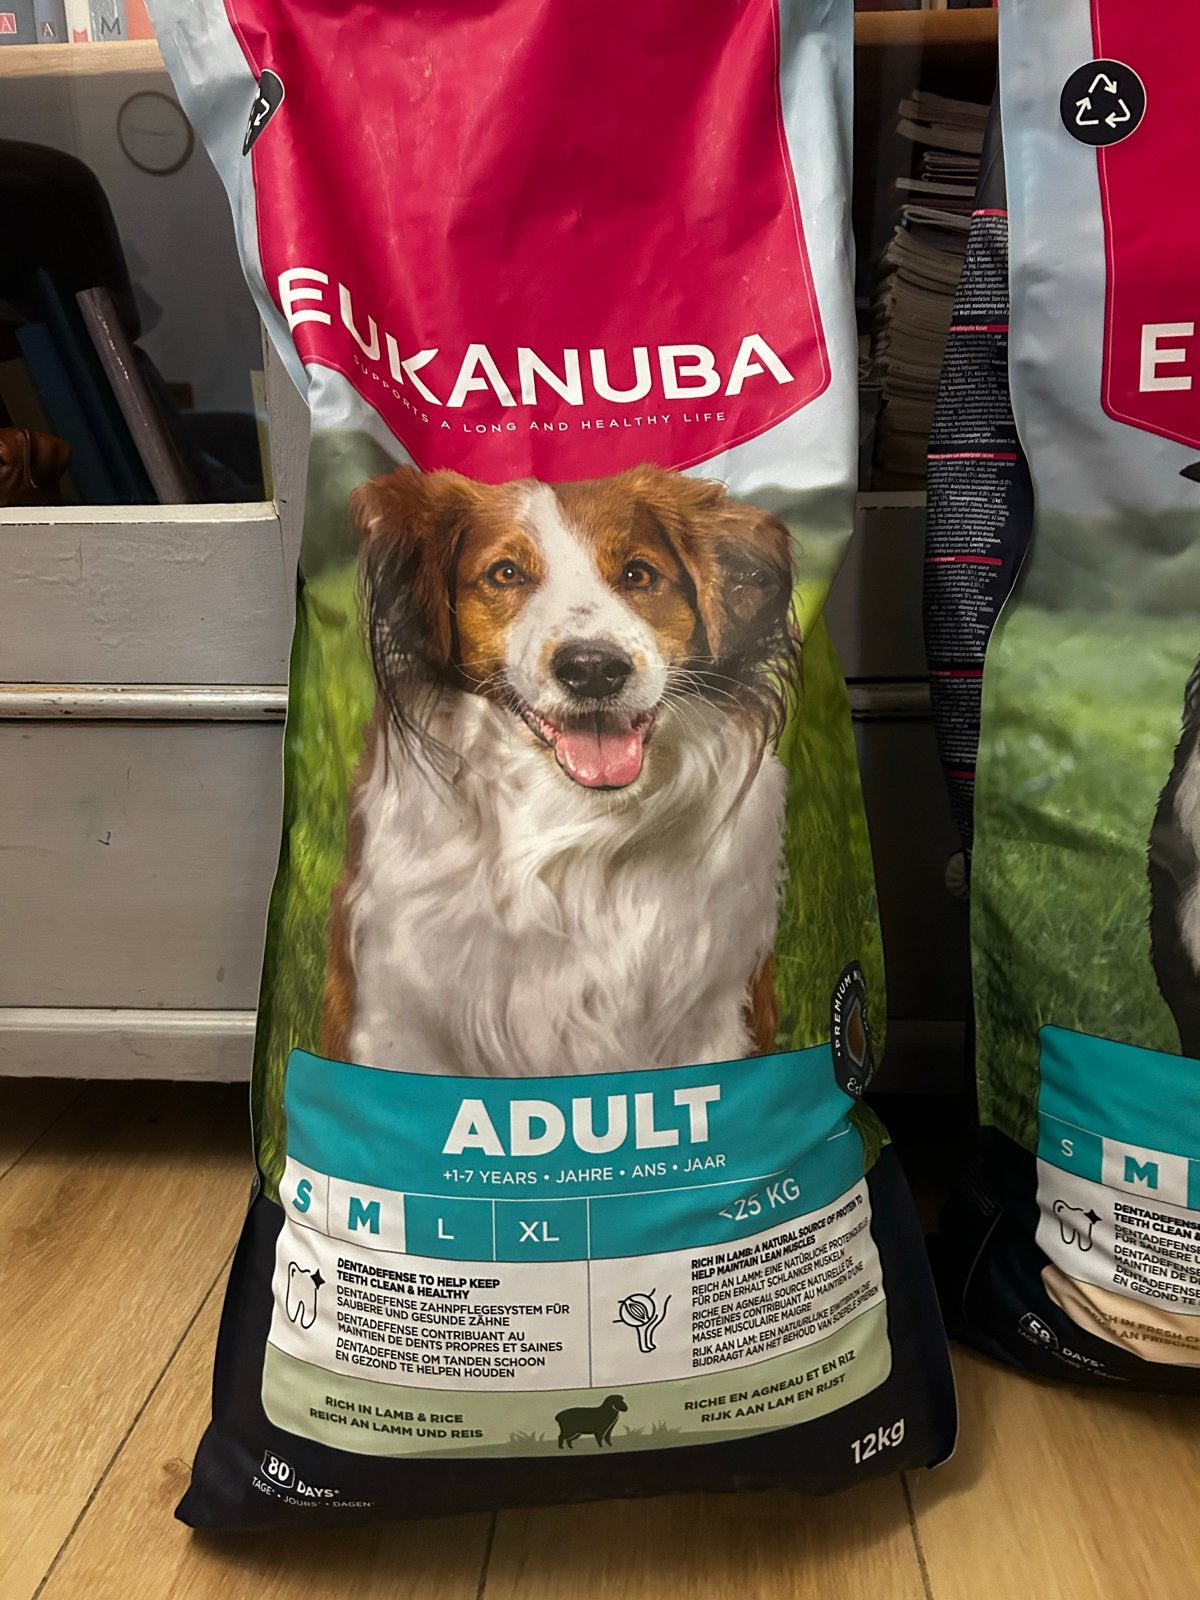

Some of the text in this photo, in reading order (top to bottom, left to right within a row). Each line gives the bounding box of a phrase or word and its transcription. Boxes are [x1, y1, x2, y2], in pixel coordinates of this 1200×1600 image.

[277, 267, 795, 408] EUKANUBA
[354, 354, 727, 433] SUPPORTS A LONG AND HEALTHY LIFE
[834, 974, 852, 1048] PREMIUM
[442, 1084, 721, 1157] ADULT
[1061, 1139, 1074, 1157] S
[443, 1154, 726, 1185] +1-7 YEARS JAHRE ANS JAAR
[1124, 1155, 1158, 1190] M
[292, 1178, 312, 1213] S
[718, 1177, 800, 1221] <25 KG
[348, 1196, 381, 1235] M
[438, 1217, 455, 1240] L
[1114, 1212, 1150, 1229] TEETH
[1152, 1222, 1192, 1239] CLEAN
[519, 1221, 560, 1242] XL
[691, 1256, 714, 1269] RICH
[715, 1253, 725, 1265] IN
[726, 1247, 754, 1262] LAMB:
[754, 1244, 761, 1254] A
[761, 1230, 798, 1251] NATURAL
[798, 1217, 826, 1238] SOURCE
[826, 1213, 836, 1225] OF
[691, 1234, 816, 1281] HELP MAINTAIN LEAN MUSCLES
[1114, 1254, 1187, 1281] MAINTIEN DE
[1139, 1241, 1192, 1263] SAUBERE
[337, 1258, 501, 1289] DENTADEFENSE TO HELP KEEP
[692, 1281, 719, 1295] REICH
[721, 1276, 735, 1289] AN
[736, 1269, 763, 1285] LAMM:
[764, 1262, 783, 1277] EINE
[783, 1243, 828, 1270] NATÜRLICHE
[692, 1248, 846, 1307] FÜR DEN ERHALT SCHLANKER MUSKELN
[337, 1270, 470, 1300] TEETH CLEAN & HEALTHY
[337, 1285, 570, 1315] DENTADEFENSE ZAHNPFLEGESYSTEM FÜR
[692, 1306, 719, 1321] RICHE
[721, 1303, 734, 1314] EN
[774, 1280, 806, 1300] SOURCE
[807, 1262, 846, 1288] NATURELLE
[1113, 1273, 1196, 1305] EN GEZOND TE
[337, 1296, 510, 1327] SAUBERE UND GESUNDE ZÄHNE
[692, 1312, 741, 1332] PROTÉINES
[743, 1293, 802, 1319] CONTRIBUANT
[803, 1288, 815, 1301] AU
[816, 1274, 848, 1296] MAINTIEN
[337, 1311, 525, 1341] DENTADEFENSE CONTRIBUANT AU
[338, 1322, 563, 1353] MAINTIEN DE DENTS PROPRES ET SAINES
[692, 1301, 812, 1343] MASSE MUSCULAIRE MAIGRE
[692, 1345, 713, 1358] RIJK
[714, 1339, 735, 1353] AAN
[736, 1334, 758, 1348] LAM:
[759, 1328, 776, 1342] EEN
[777, 1308, 829, 1336] NATUURLIJKE
[1029, 1320, 1051, 1343] 58
[1120, 1330, 1140, 1340] AN
[1121, 1318, 1136, 1328] IN
[1138, 1322, 1183, 1340] FRESH
[336, 1337, 546, 1367] DENTADEFENSE OM TANDEN SCHOON
[692, 1349, 744, 1368] BIJDRAAGT
[745, 1343, 764, 1357] AAN
[766, 1336, 781, 1350] HET
[782, 1324, 816, 1344] BEHOUD
[817, 1318, 832, 1331] VAN
[335, 1349, 515, 1378] EN GEZOND TE HELPEN HOUDEN
[684, 1350, 856, 1411] RICHE EN AGNEAU ET EN RIZ
[325, 1395, 464, 1423] RICH IN LAMB & RICE
[701, 1373, 846, 1423] RIJK AAN LAM EN RIJST
[309, 1408, 483, 1438] REICH AN LAMM UND REIS
[851, 1418, 905, 1465] 12kg
[268, 1456, 290, 1481] 80
